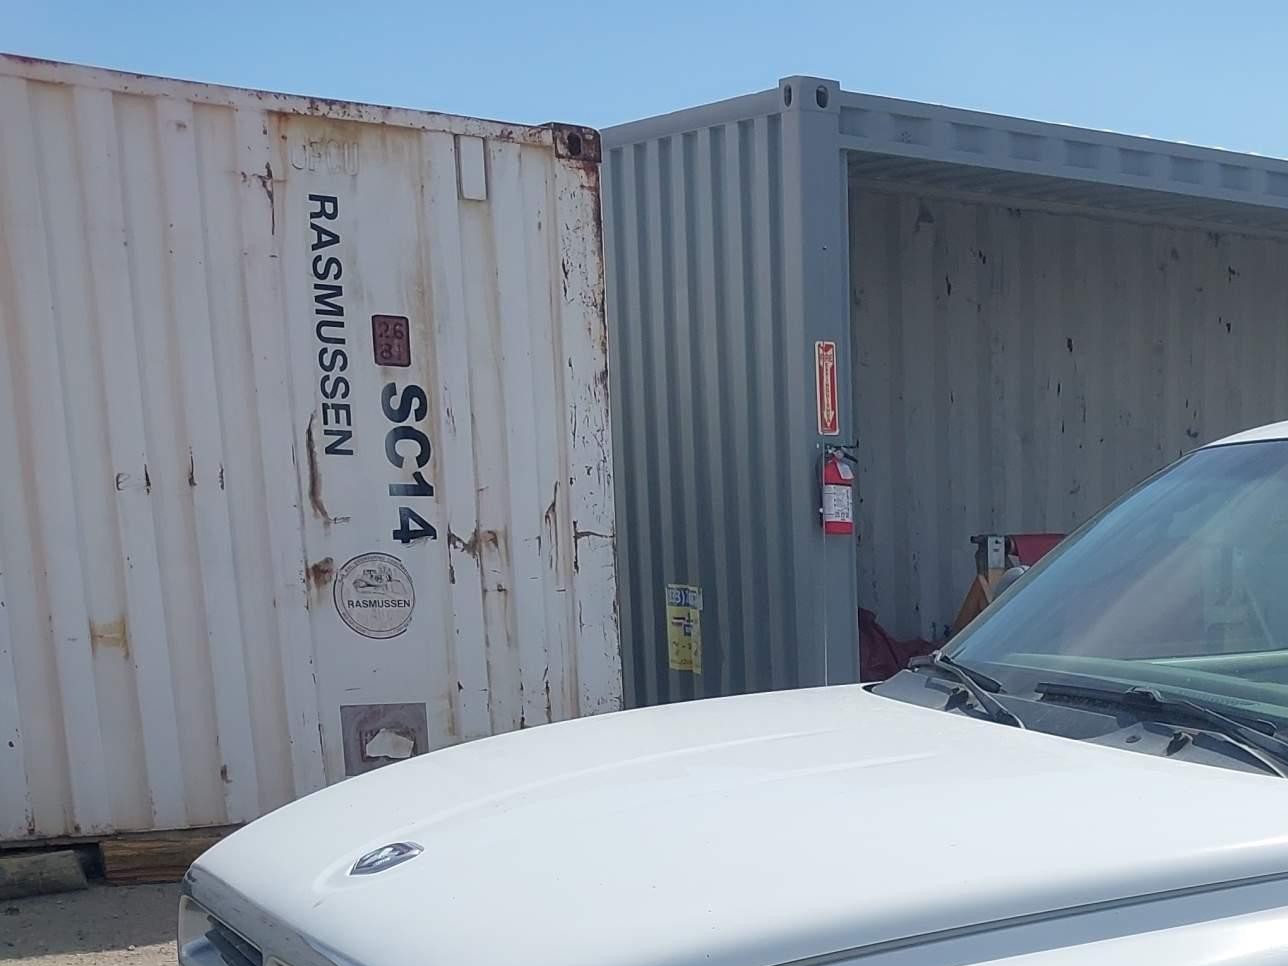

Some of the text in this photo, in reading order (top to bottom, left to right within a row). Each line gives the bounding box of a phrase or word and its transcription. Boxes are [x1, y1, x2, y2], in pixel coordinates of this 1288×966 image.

[308, 193, 354, 457] RASMUSSEN
[381, 382, 438, 545] SC14
[347, 599, 411, 608] RASMUSSEN
